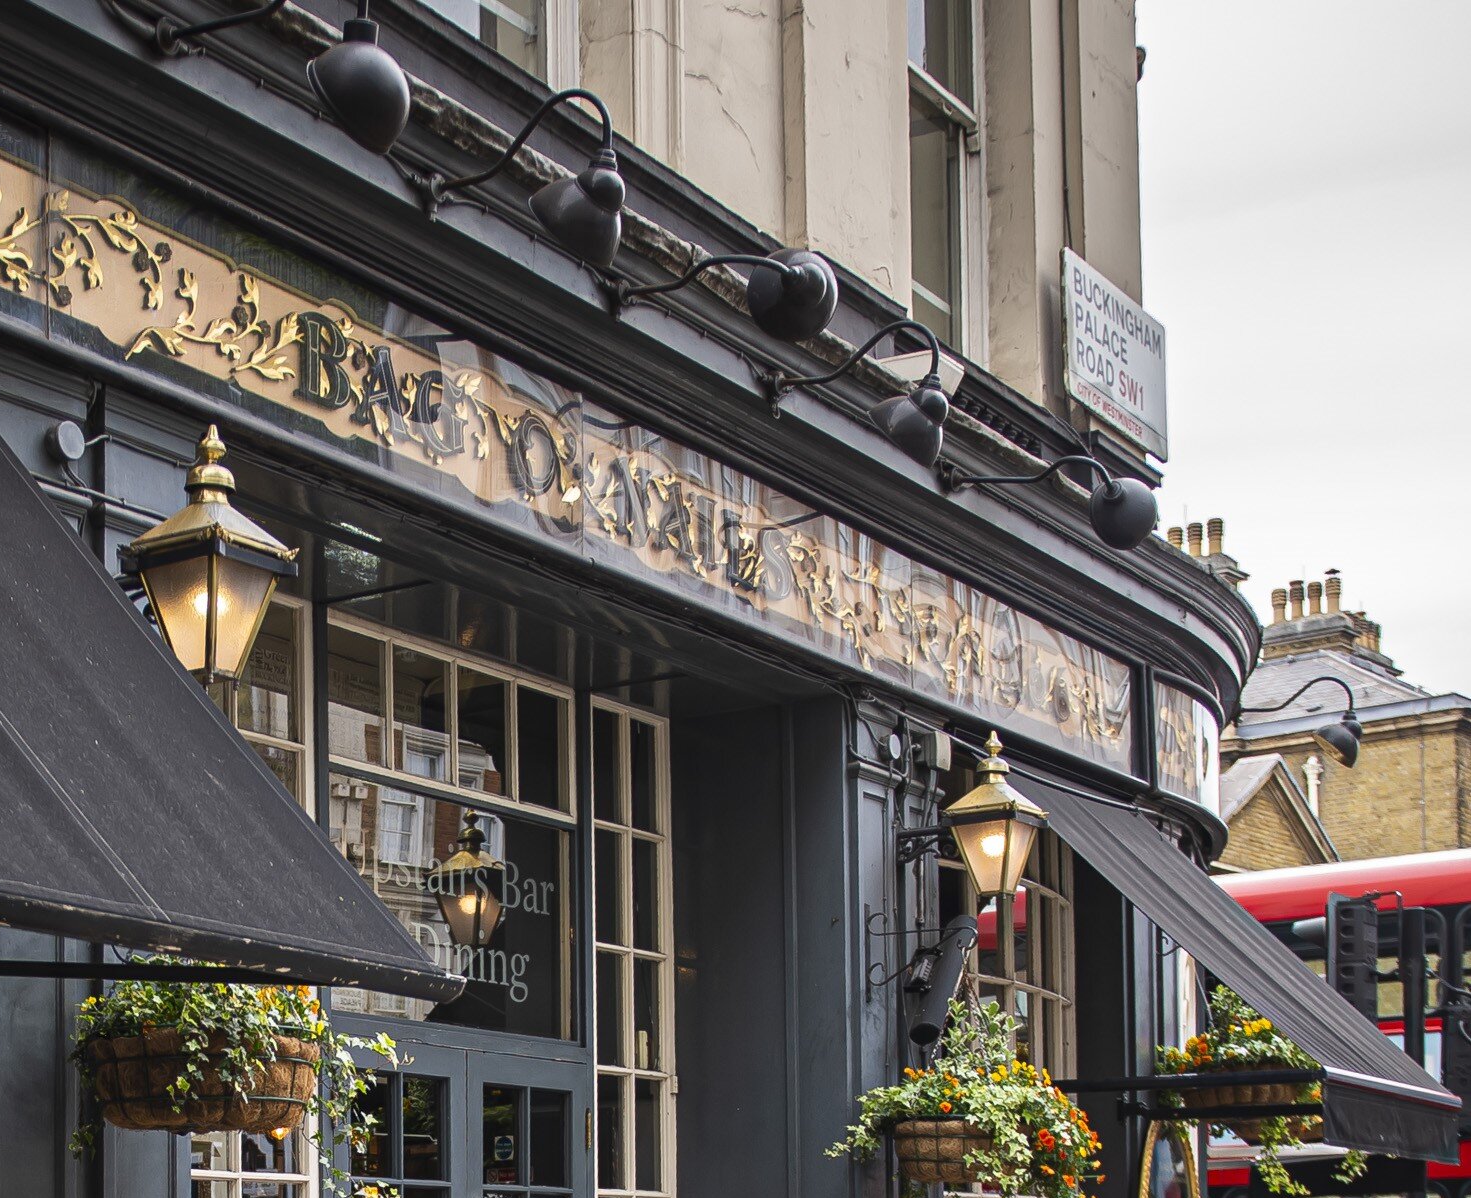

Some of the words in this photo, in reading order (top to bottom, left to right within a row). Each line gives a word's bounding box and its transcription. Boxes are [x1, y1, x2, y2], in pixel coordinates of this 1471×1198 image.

[1073, 266, 1163, 360] BUCKINGHAM
[1074, 301, 1129, 366] PALACE
[292, 311, 468, 458] BAG
[1076, 337, 1115, 387] ROAD
[1118, 370, 1145, 412] SW1
[498, 861, 554, 916] Bar
[410, 921, 530, 1003] Dining
